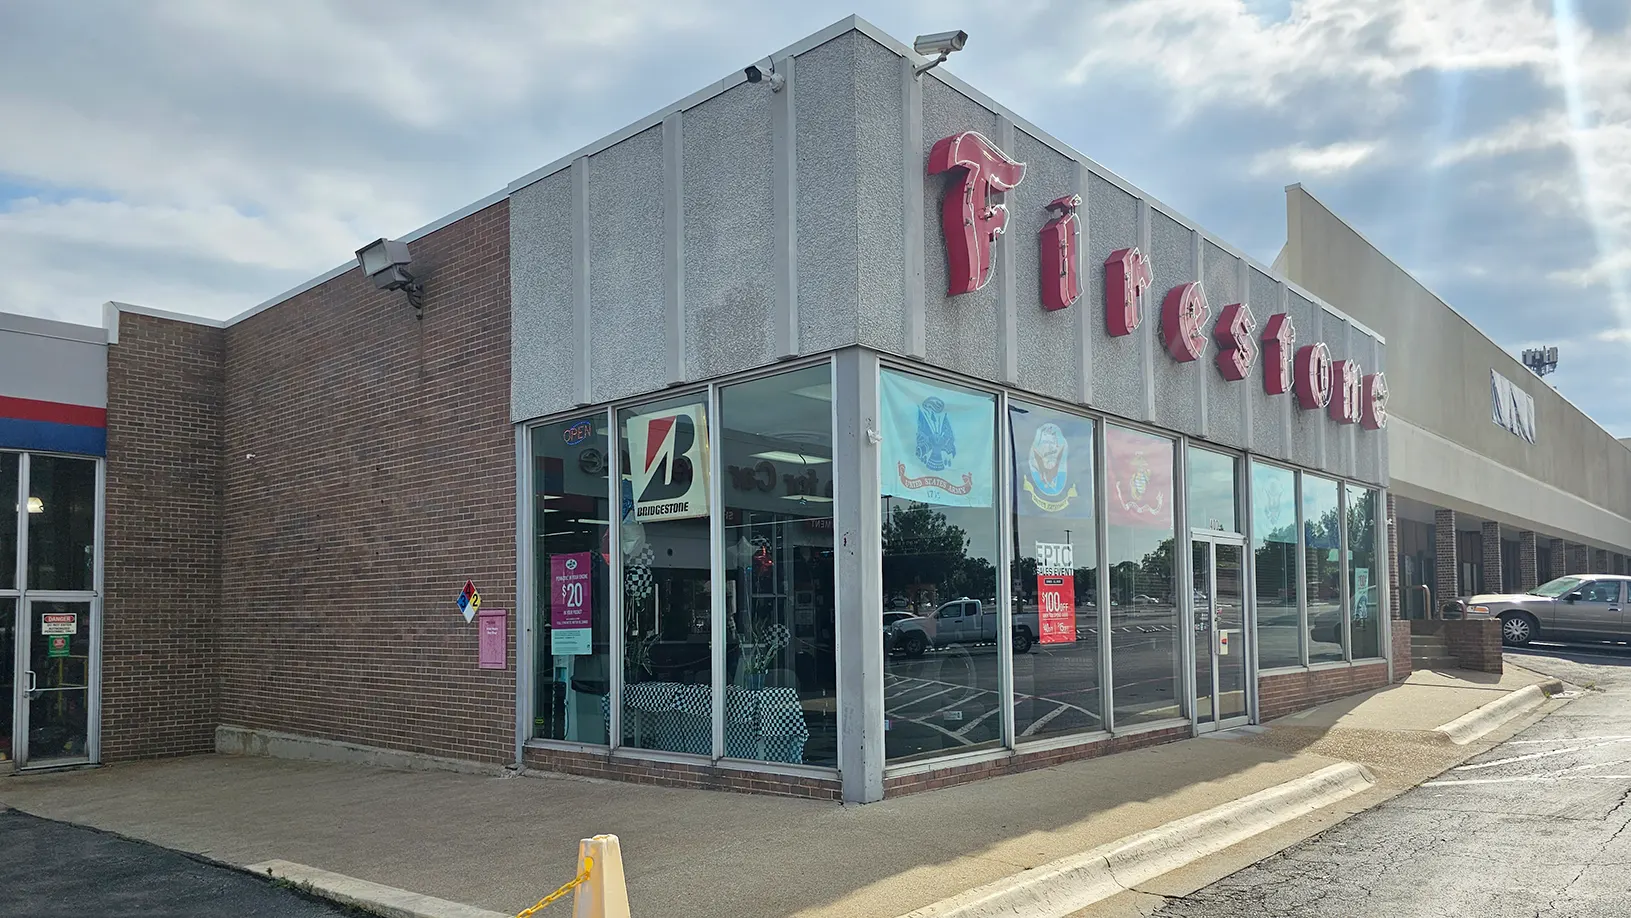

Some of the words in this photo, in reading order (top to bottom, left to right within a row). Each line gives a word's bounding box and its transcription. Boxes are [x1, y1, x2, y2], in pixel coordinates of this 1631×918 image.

[928, 130, 1388, 430] Firestone
[563, 425, 592, 442] OPEN
[904, 479, 923, 489] UNITED
[924, 478, 947, 490] STATES
[947, 485, 966, 495] ARMY
[637, 502, 689, 517] BRIDGESTONE
[1036, 545, 1071, 567] EPIC
[1036, 567, 1054, 576] SALES
[1054, 568, 1074, 576] EVENT
[466, 583, 471, 595] 4
[562, 582, 583, 608] $20
[460, 595, 466, 608] 3
[472, 594, 479, 607] 2
[1042, 591, 1060, 612] $100
